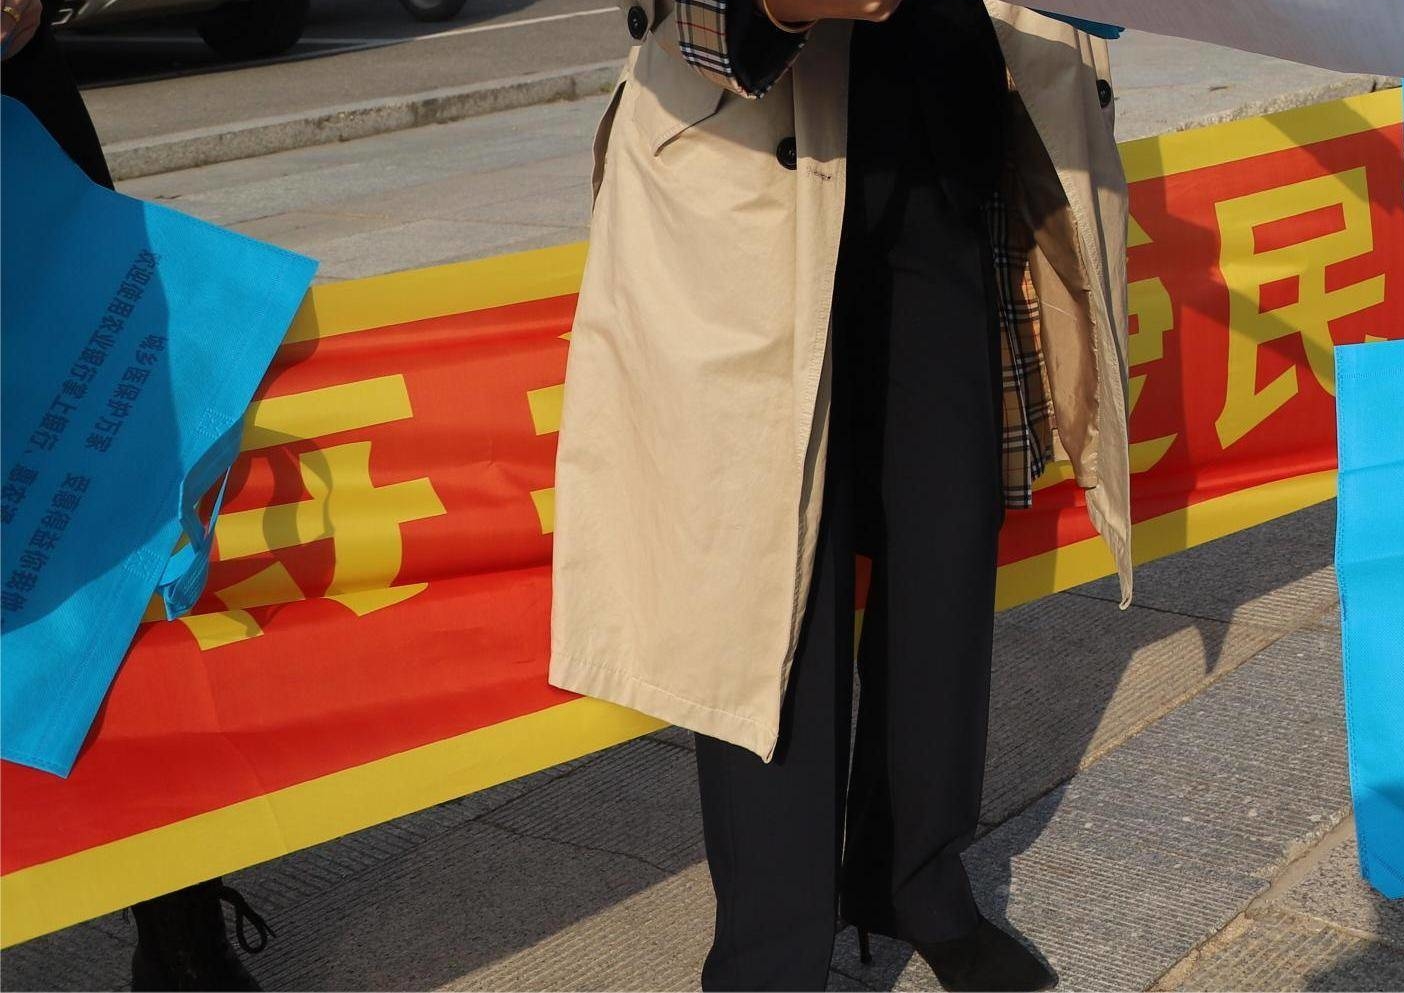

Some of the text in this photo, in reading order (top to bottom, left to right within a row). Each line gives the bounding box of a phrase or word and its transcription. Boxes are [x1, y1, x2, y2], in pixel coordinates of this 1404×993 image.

[86, 335, 169, 453] 城乡医保护万家
